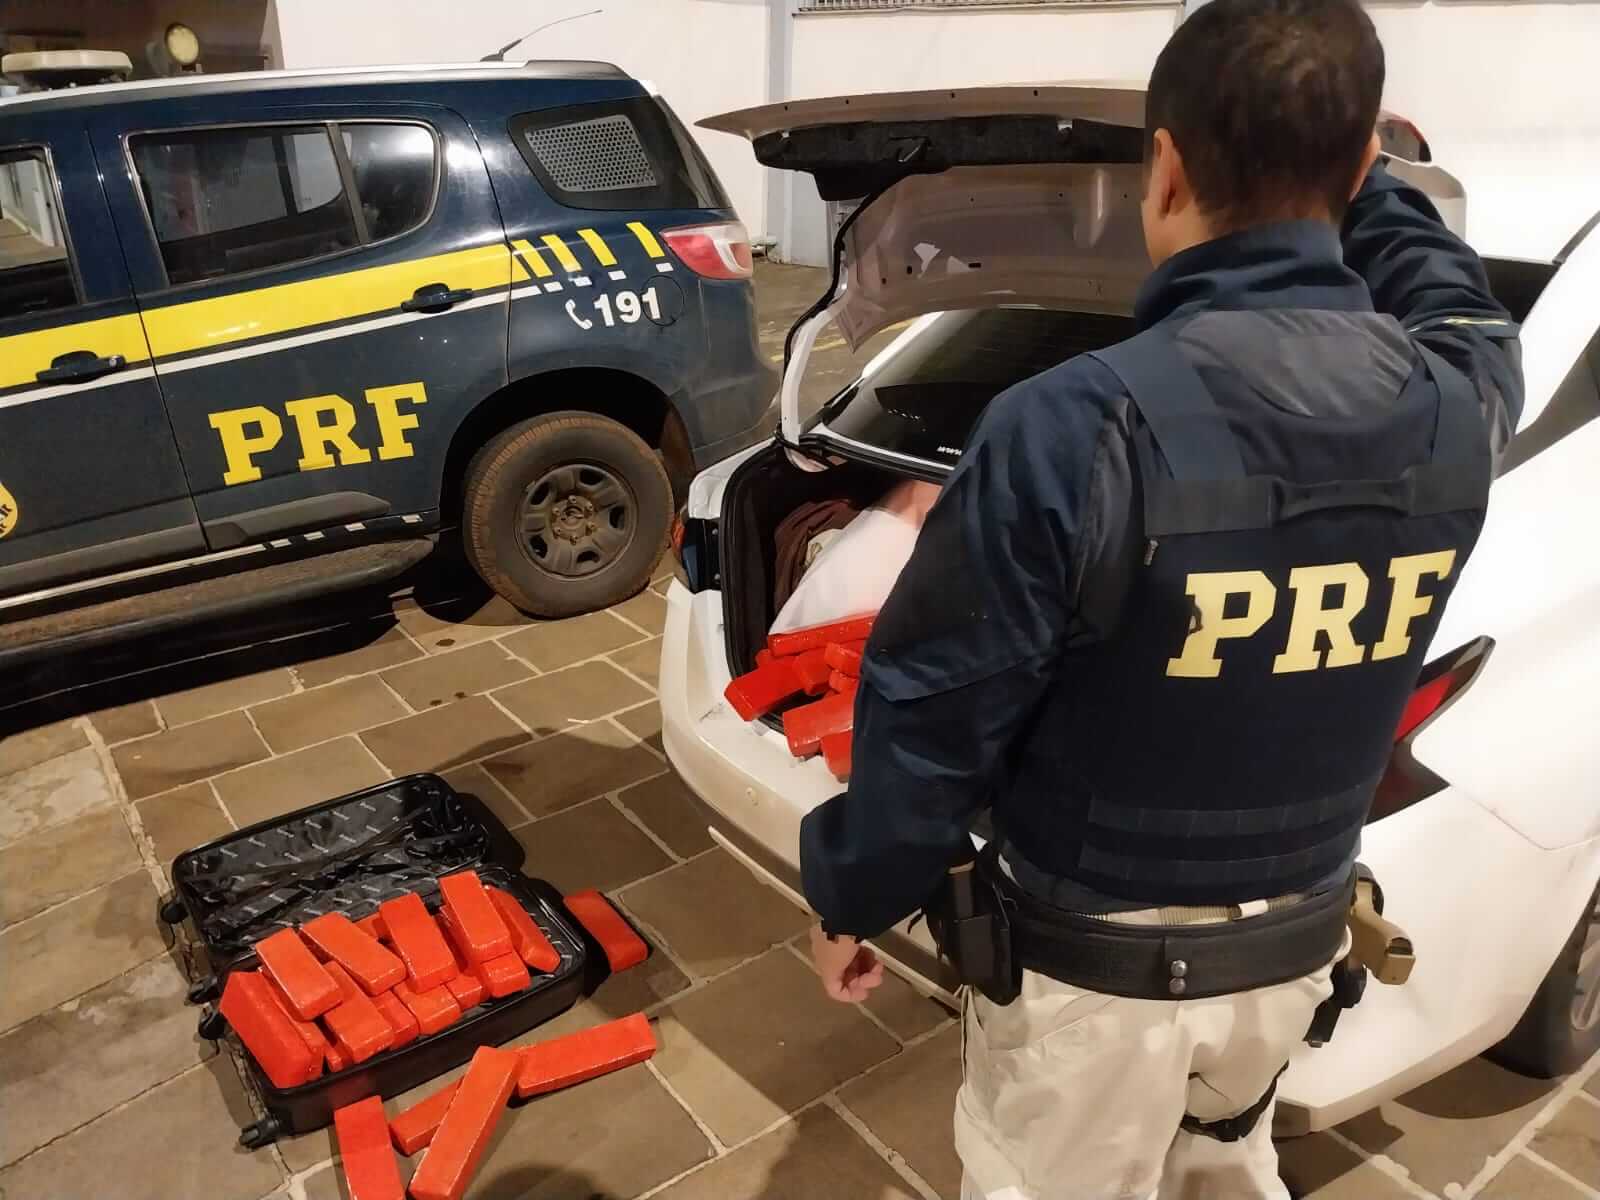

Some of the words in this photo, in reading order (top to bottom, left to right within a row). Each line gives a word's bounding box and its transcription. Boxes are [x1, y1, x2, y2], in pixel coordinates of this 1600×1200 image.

[593, 287, 661, 327] 191
[208, 381, 428, 486] PRF
[1166, 549, 1456, 678] PRF
